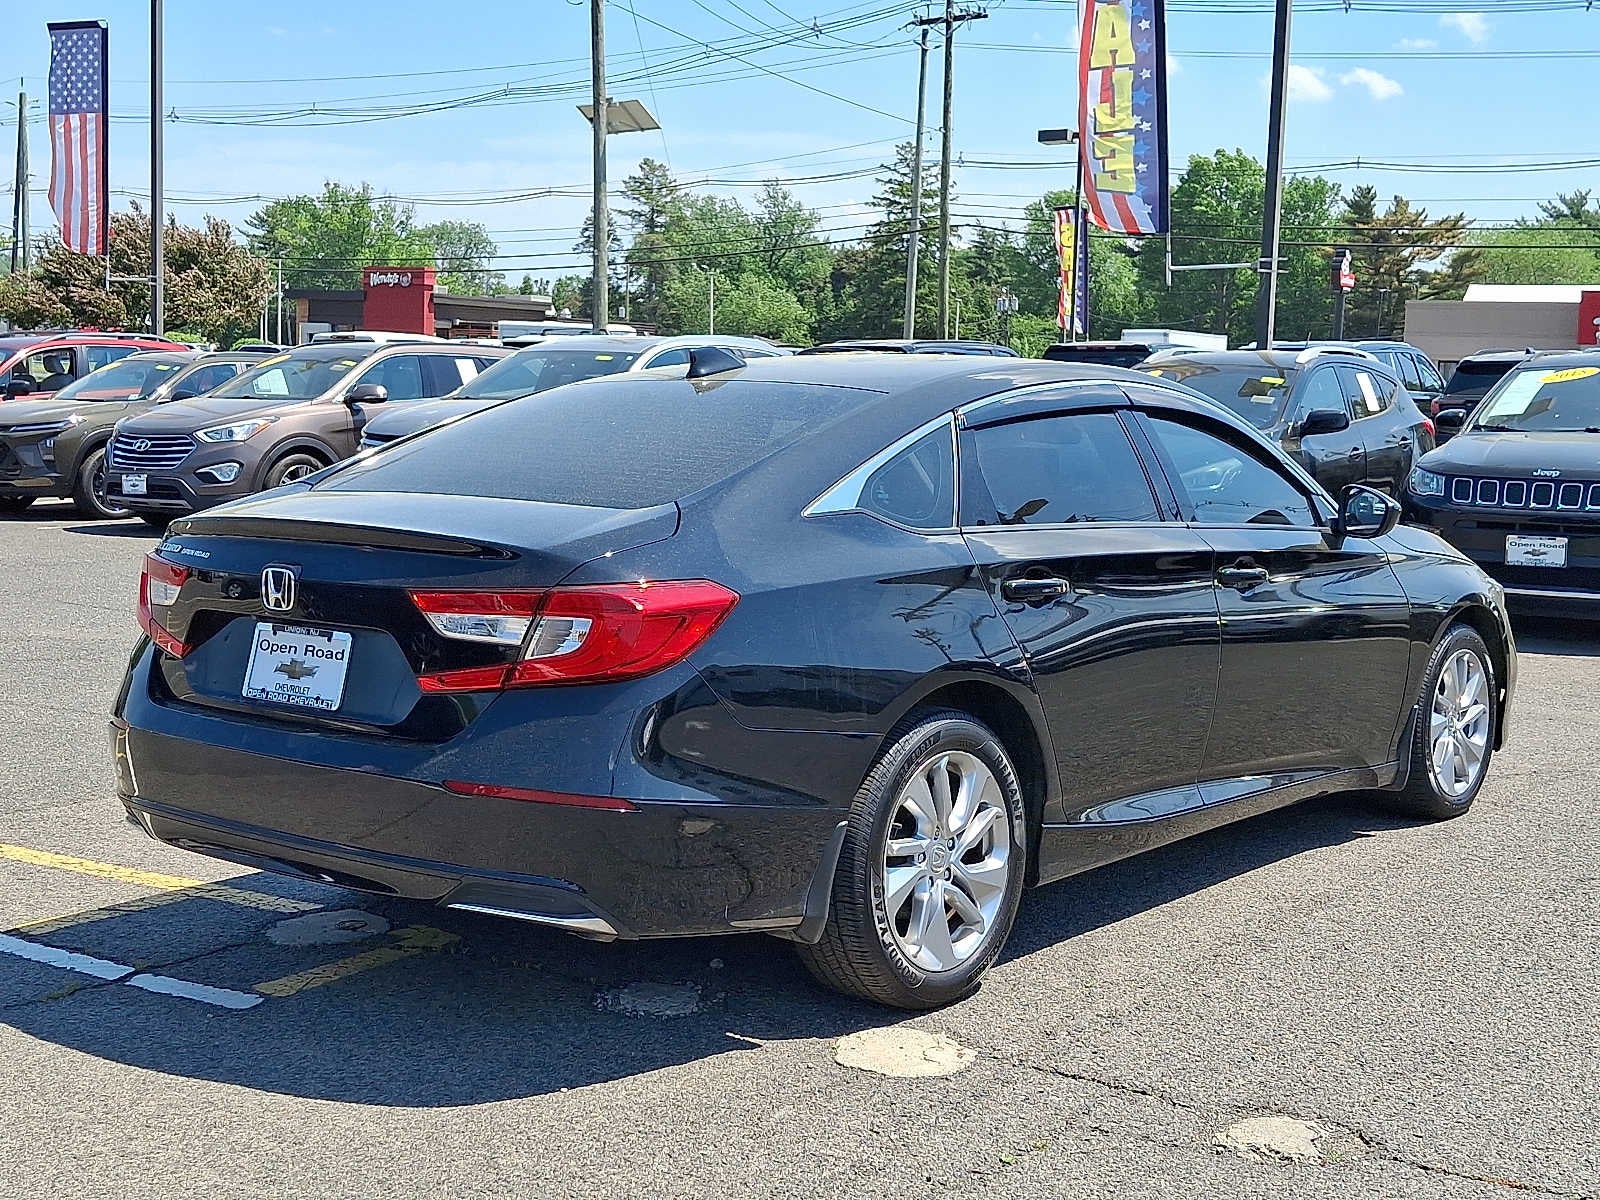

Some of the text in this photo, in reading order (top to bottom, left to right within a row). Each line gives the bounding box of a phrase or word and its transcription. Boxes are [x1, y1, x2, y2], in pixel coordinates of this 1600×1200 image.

[369, 271, 400, 288] Wendy's
[1532, 468, 1561, 478] Jeep
[259, 638, 346, 662] Open Road
[274, 682, 311, 696] CHEVROLET
[247, 688, 334, 710] OPEN ROAD CHEVROLET
[873, 884, 918, 984] GOODYEAR
